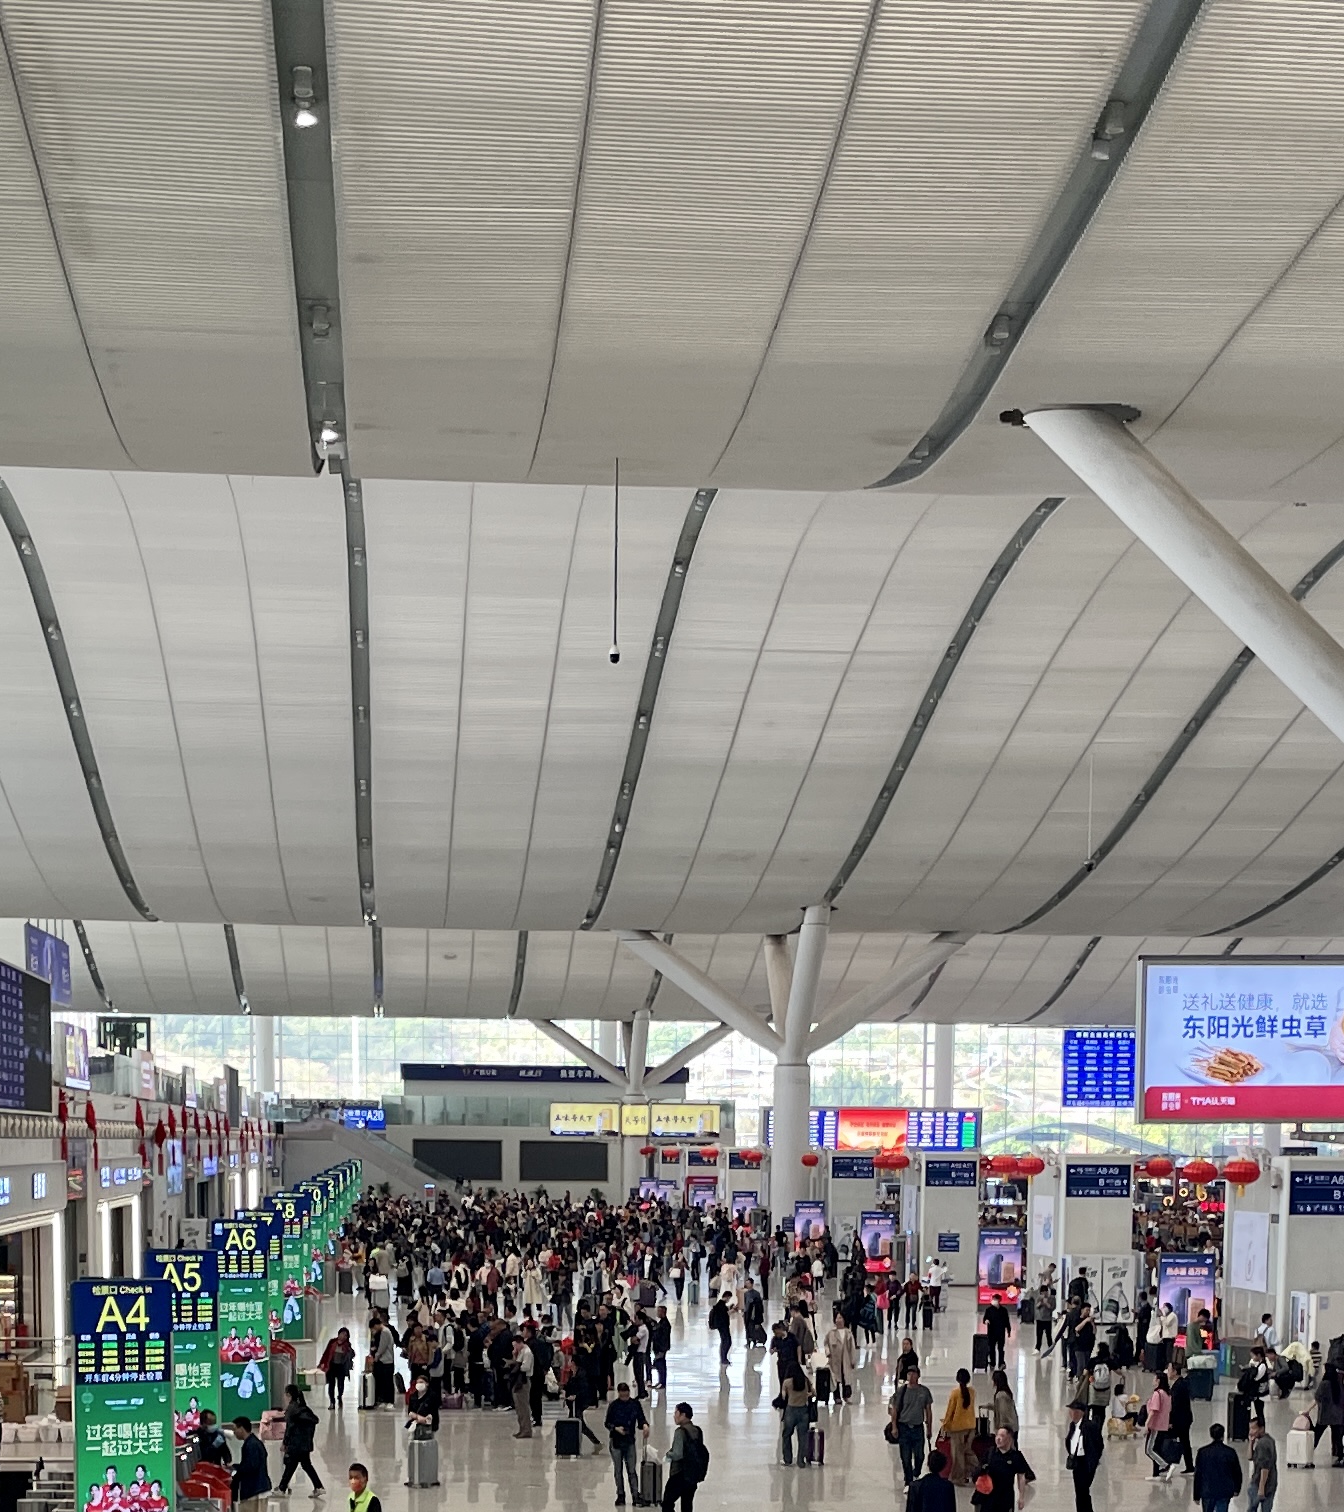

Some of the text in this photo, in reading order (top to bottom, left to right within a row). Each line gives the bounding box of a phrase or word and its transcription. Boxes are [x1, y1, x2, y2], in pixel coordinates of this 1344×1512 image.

[1182, 1015, 1327, 1039] 东阳光鲜虫草
[366, 1109, 385, 1121] A20
[1333, 1189, 1342, 1200] B
[225, 1229, 257, 1251] A6
[163, 1262, 202, 1292] A5
[95, 1294, 150, 1333] A4
[86, 1421, 164, 1441] 过年喝怡宝
[86, 1438, 164, 1457] 一起过大年
